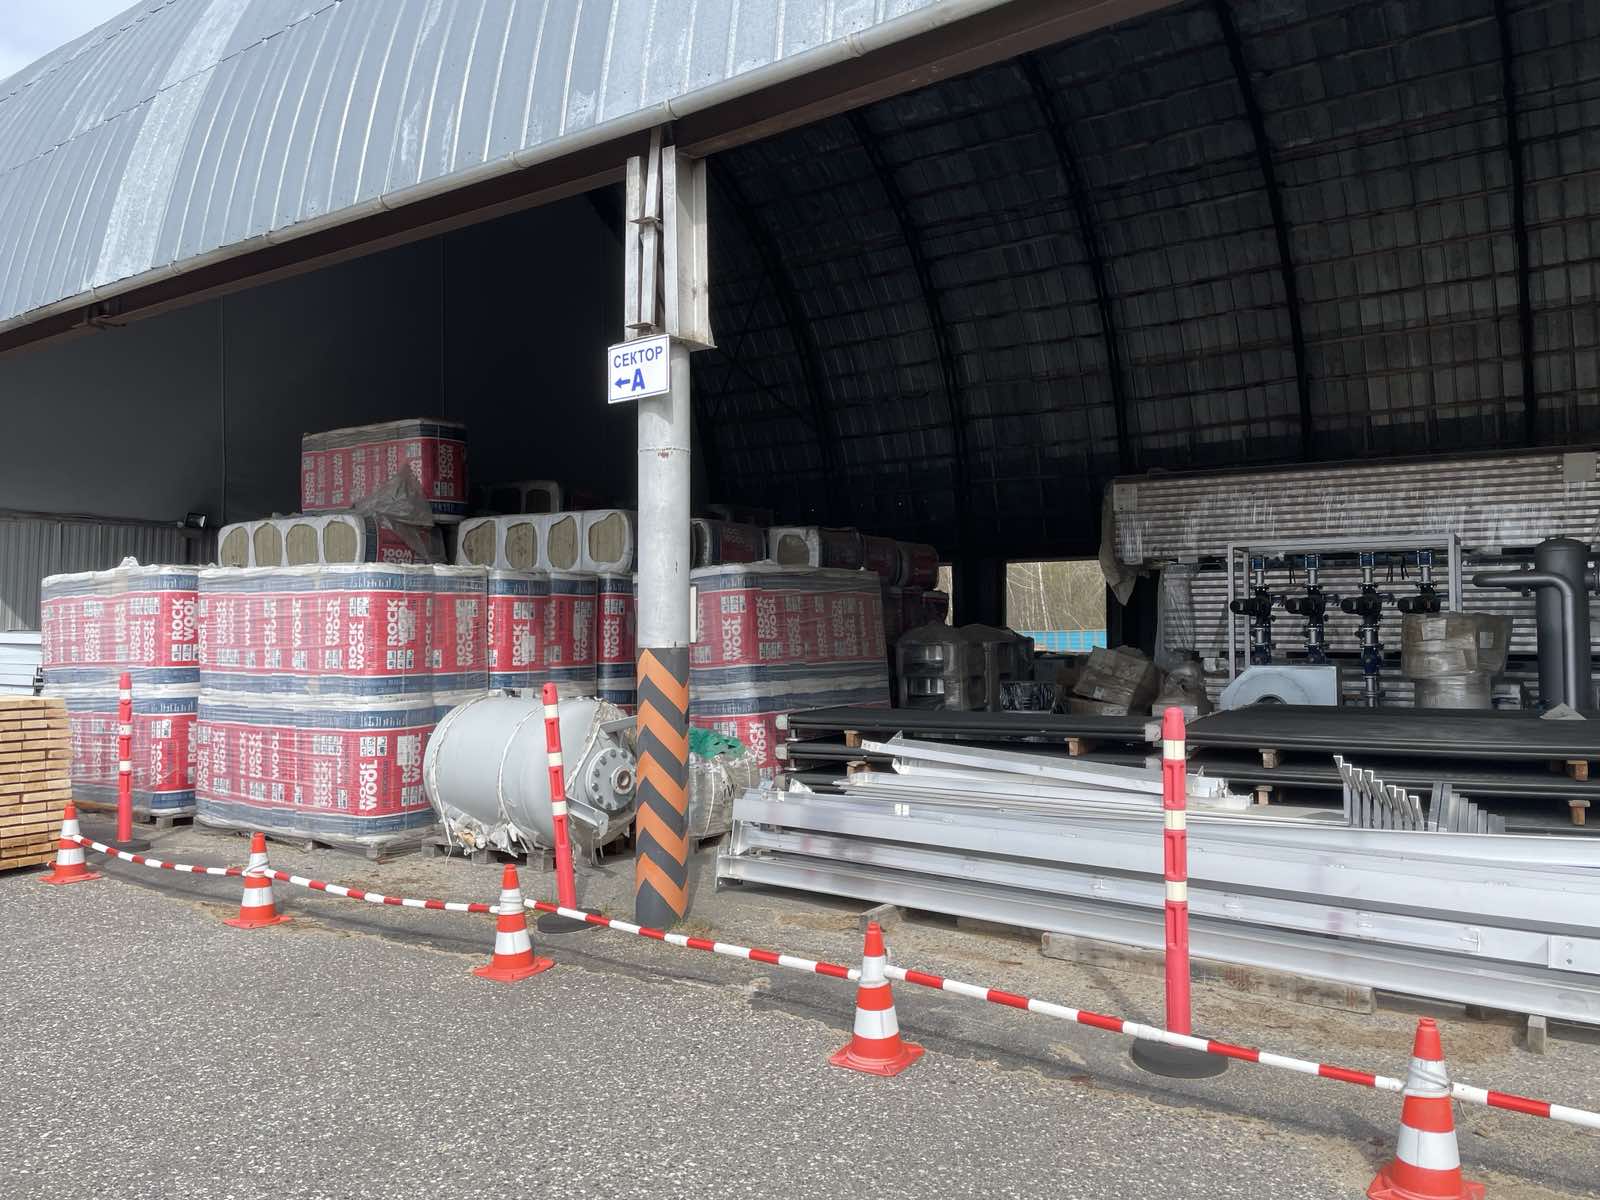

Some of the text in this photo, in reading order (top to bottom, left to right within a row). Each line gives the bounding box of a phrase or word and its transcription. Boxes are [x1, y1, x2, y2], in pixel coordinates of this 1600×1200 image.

[613, 346, 663, 368] СЕКТОР
[631, 368, 646, 392] А
[171, 598, 183, 641] ROCK
[183, 596, 195, 641] WOOL
[325, 599, 333, 646] ROCK
[333, 596, 341, 646] WOOL
[387, 599, 398, 646] ROCK
[611, 616, 619, 658] WOOL
[722, 618, 732, 660] ROCK
[732, 615, 741, 660] WOOL
[349, 622, 357, 669] ROCK
[357, 620, 365, 670] WOOL
[513, 624, 522, 666] ROCK
[188, 720, 197, 763] ROCK
[758, 720, 767, 765] WOOL
[366, 760, 378, 811] WOOL
